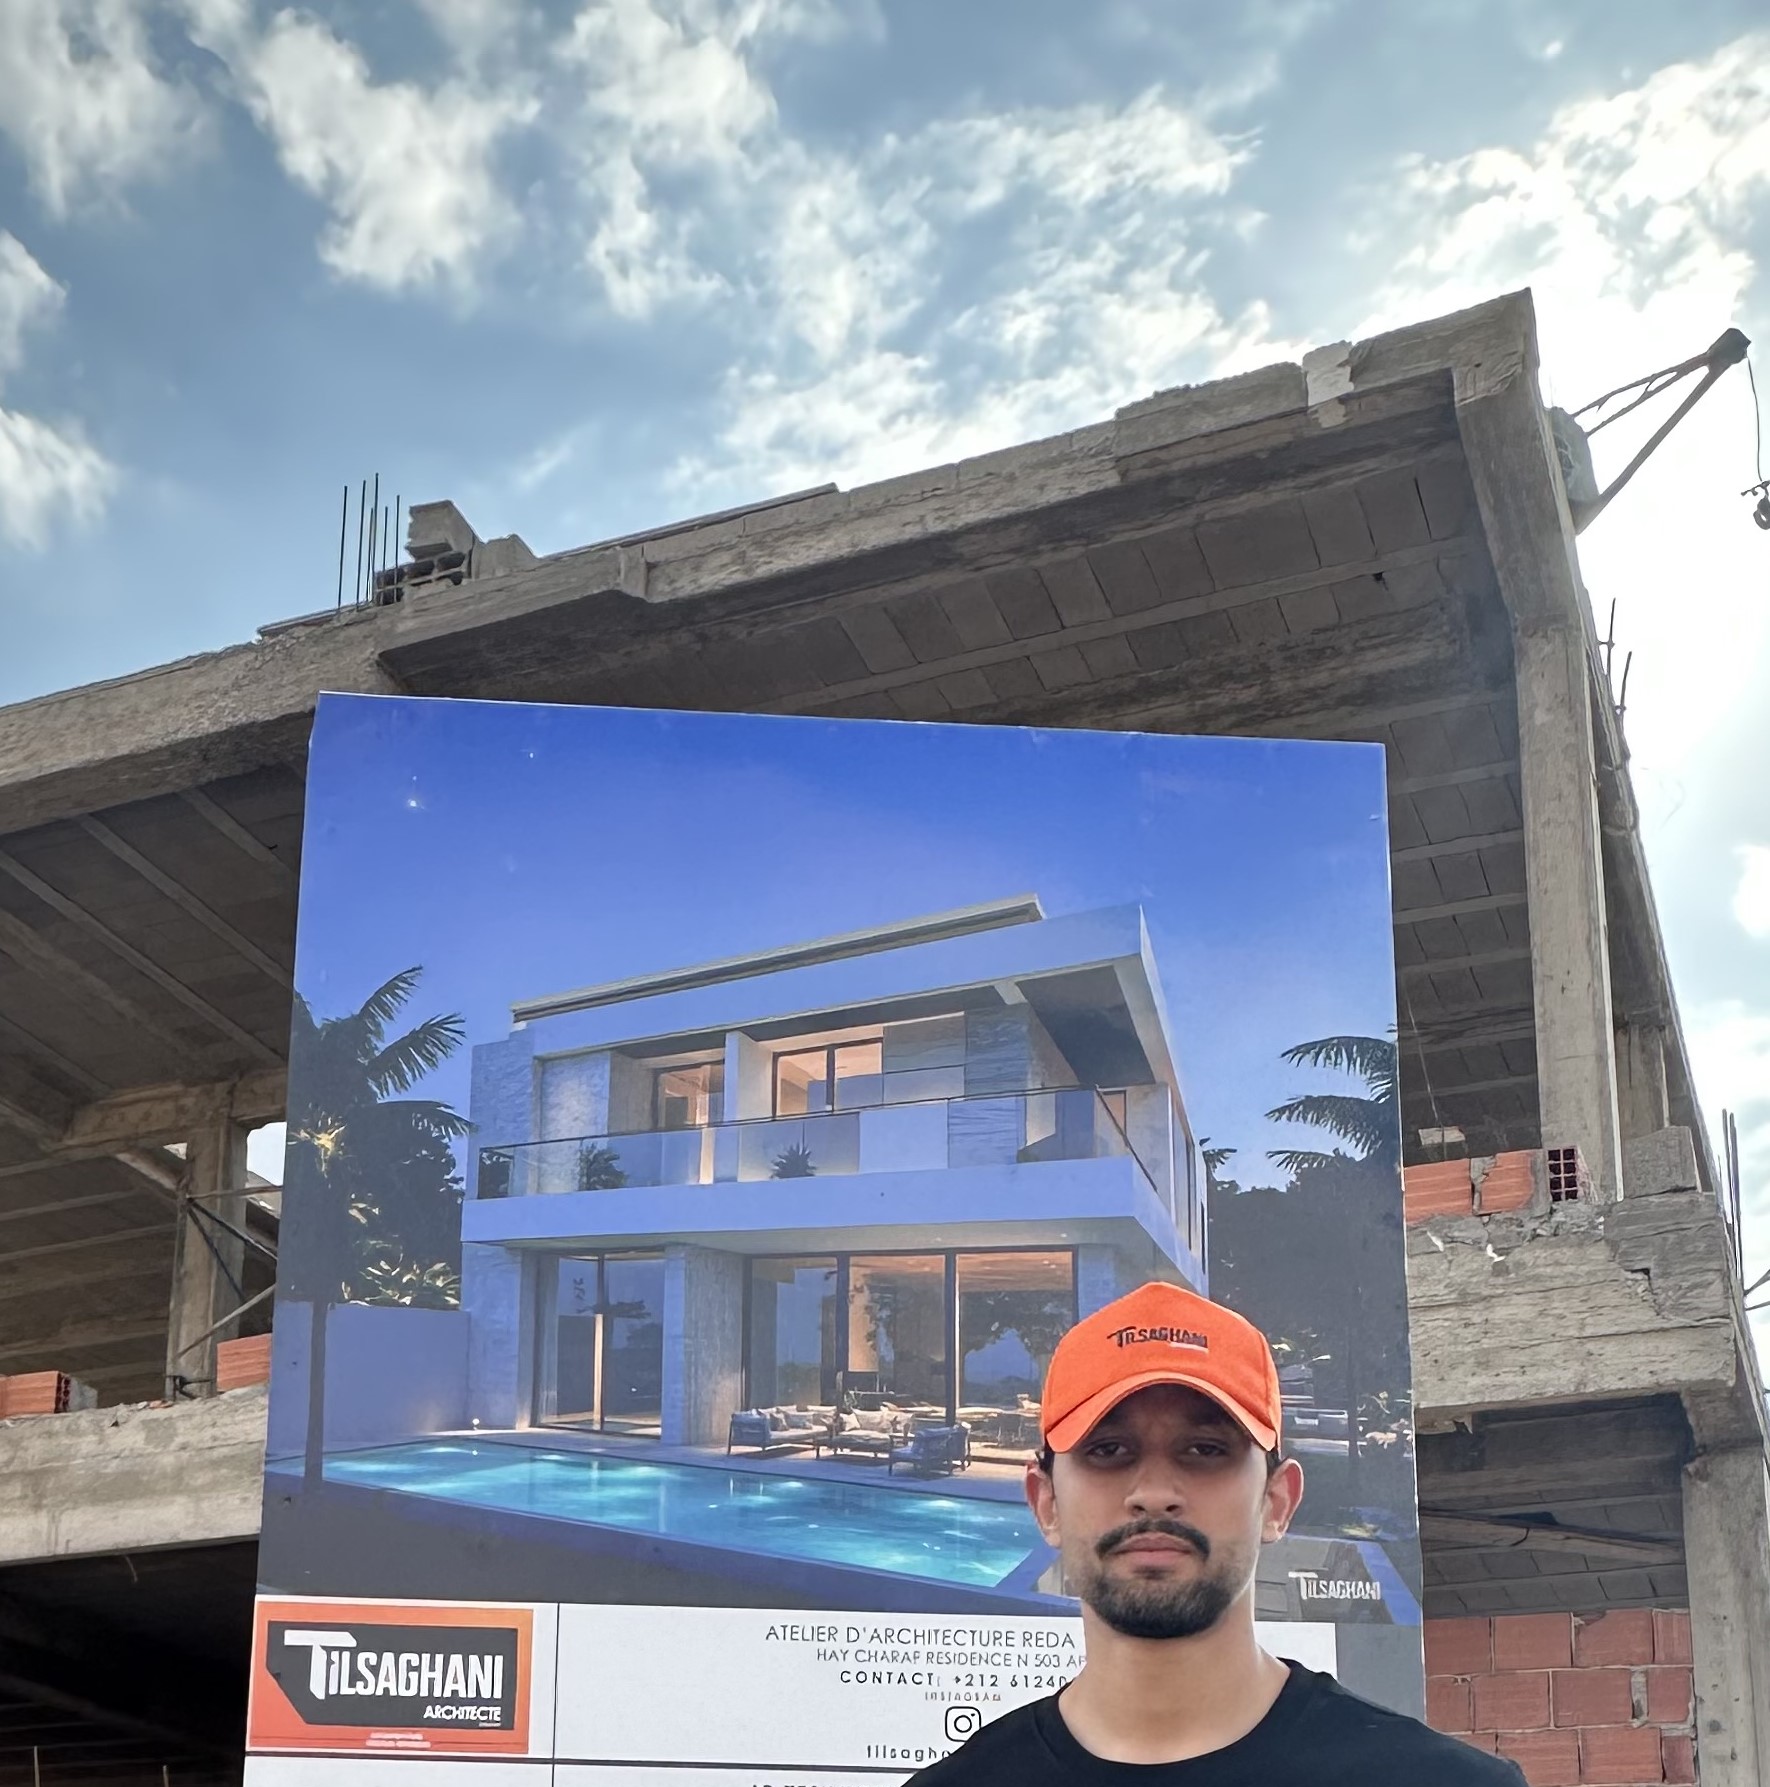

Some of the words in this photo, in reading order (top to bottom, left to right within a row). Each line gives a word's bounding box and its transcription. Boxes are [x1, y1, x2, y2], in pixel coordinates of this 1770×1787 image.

[765, 1624, 839, 1643] ATELIER
[847, 1626, 1015, 1647] D'ARCHITECTURE
[1022, 1631, 1075, 1648] REDA
[284, 1629, 503, 1700] TILSAGHANI
[817, 1648, 848, 1662] HAY
[855, 1650, 920, 1664] CHARAF
[927, 1651, 1012, 1667] RESIDENCE
[1034, 1654, 1060, 1668] 503
[954, 1673, 998, 1688] +212
[423, 1705, 502, 1721] ARCHITECTE
